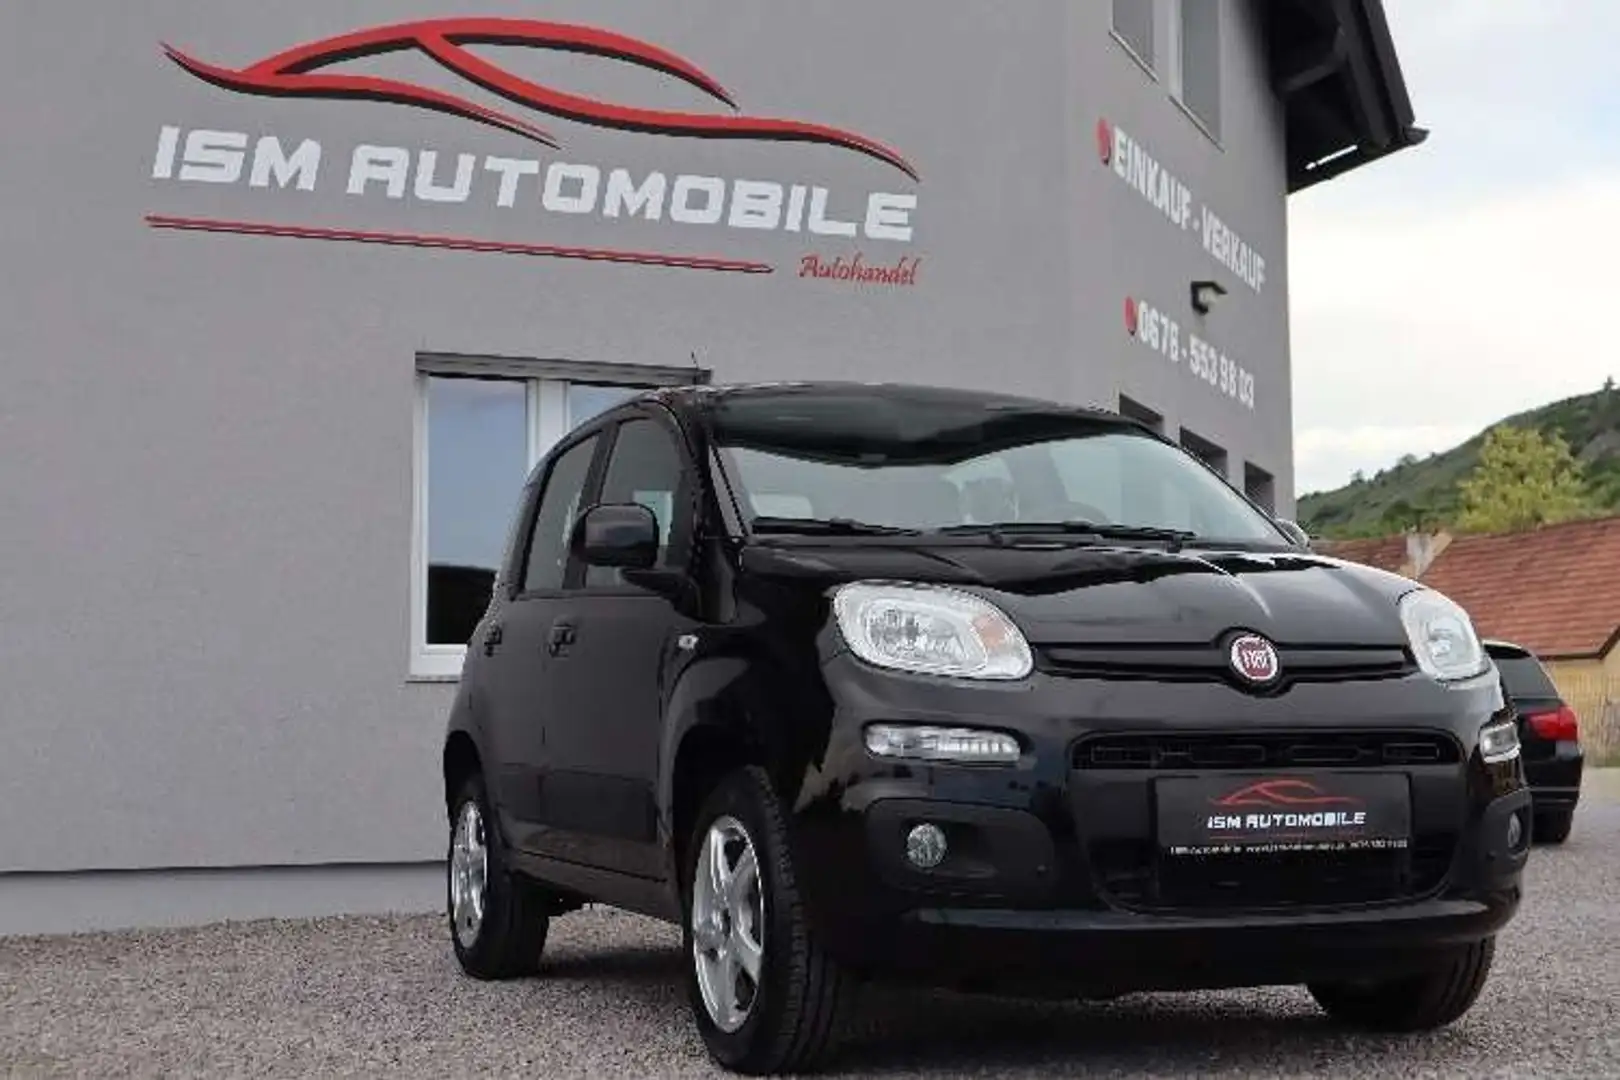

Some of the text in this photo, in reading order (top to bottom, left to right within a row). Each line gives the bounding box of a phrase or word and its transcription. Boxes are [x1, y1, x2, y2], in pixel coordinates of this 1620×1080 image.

[152, 125, 918, 241] ISM AUTOMOBILE
[1113, 126, 1192, 229] EINKAUF
[1202, 205, 1265, 293] VERKAUF
[800, 252, 920, 285] Autohandel
[1206, 812, 1367, 829] ISM AUTOMOBILE
